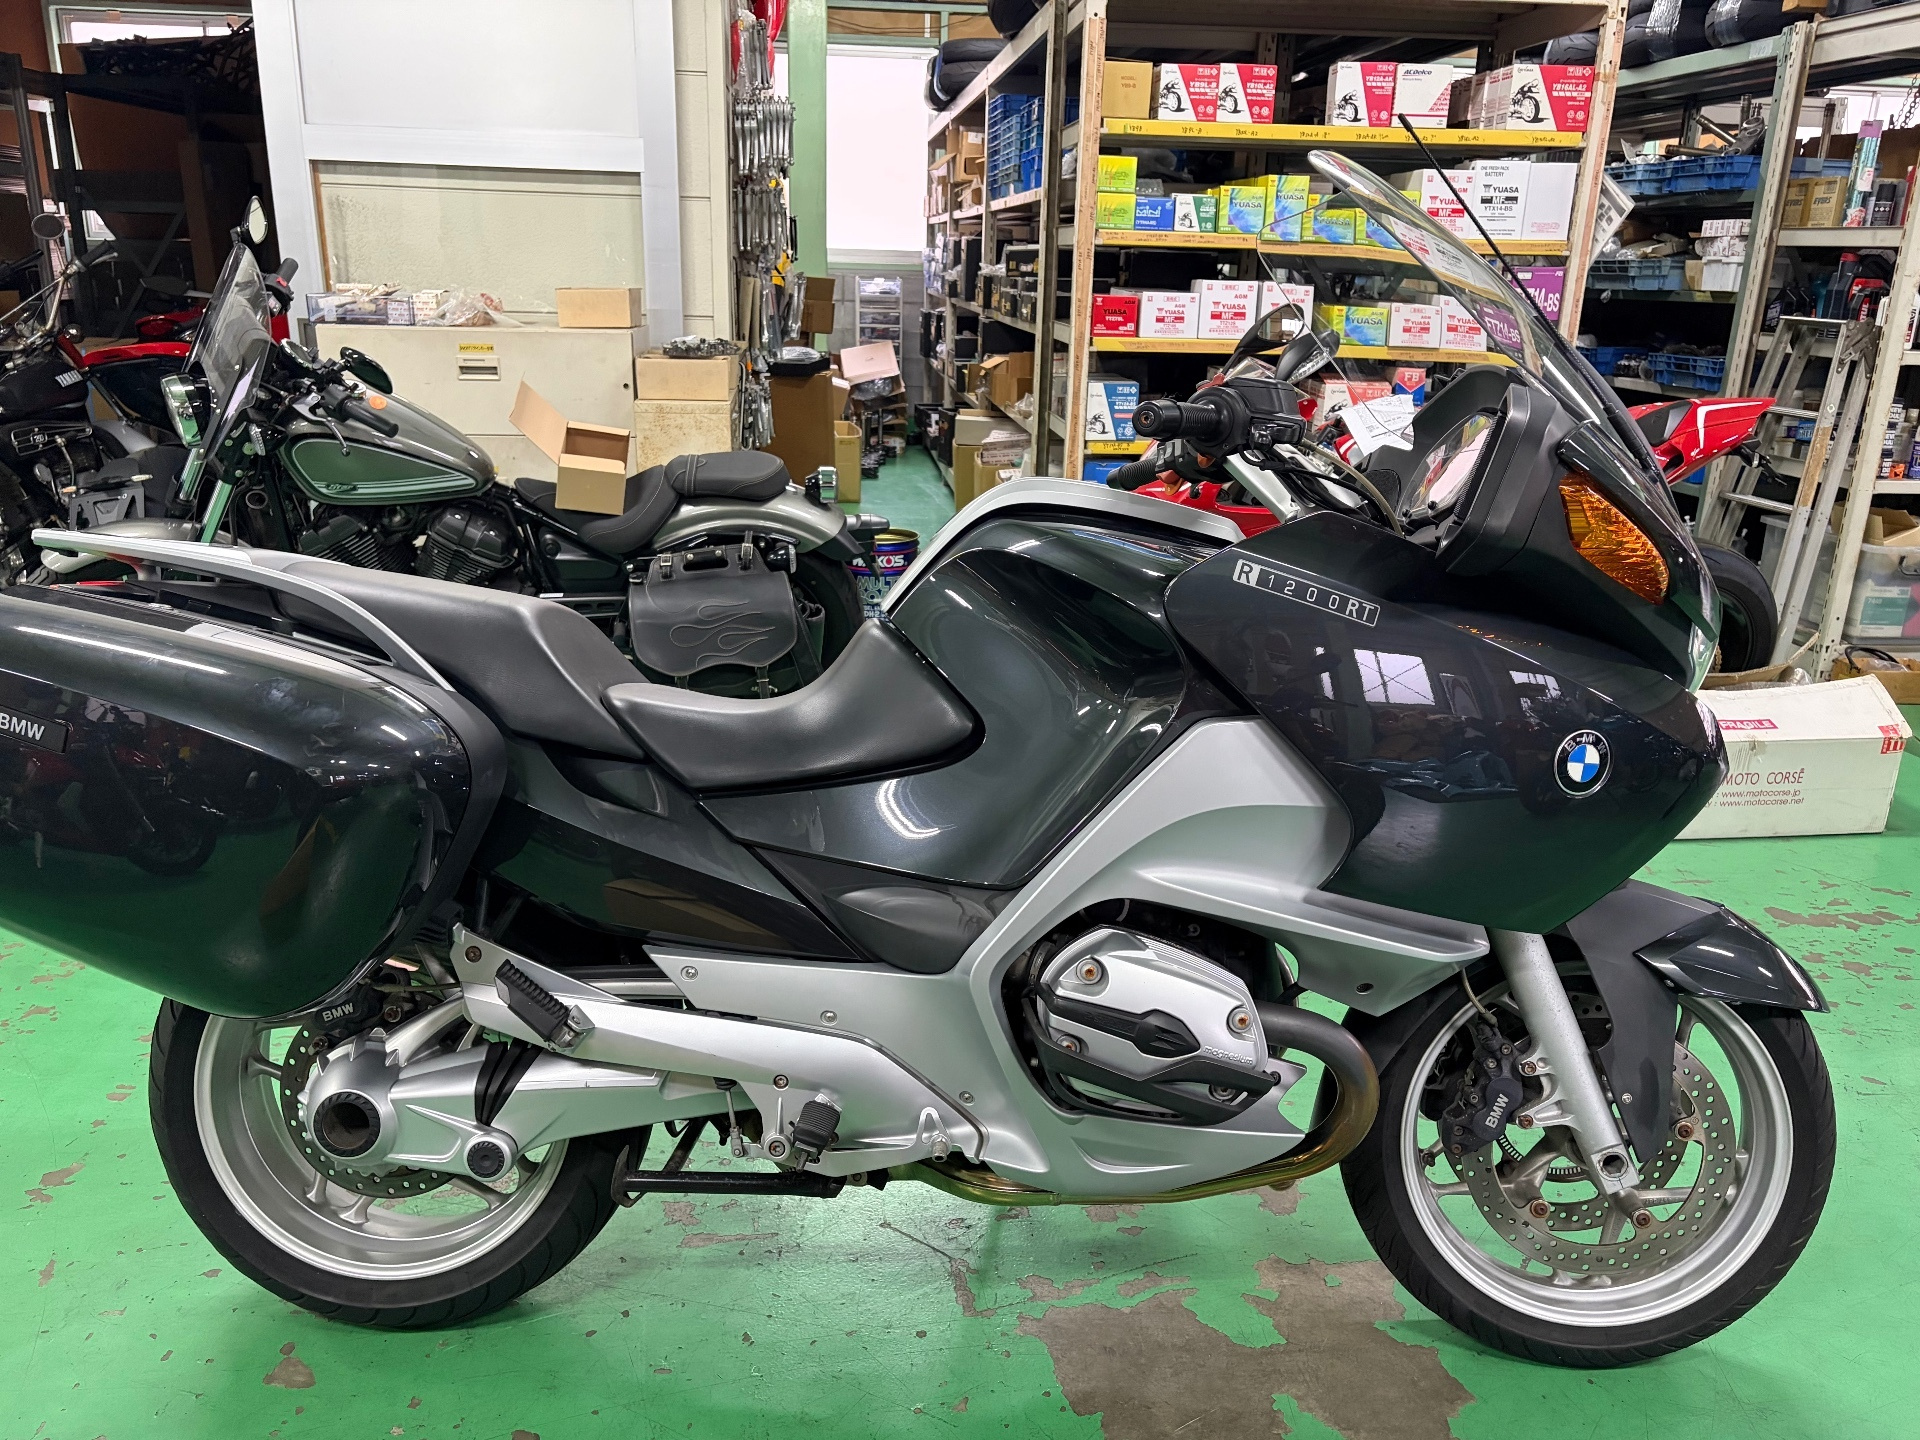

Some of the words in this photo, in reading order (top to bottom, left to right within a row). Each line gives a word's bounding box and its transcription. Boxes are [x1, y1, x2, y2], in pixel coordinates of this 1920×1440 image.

[1552, 83, 1588, 92] YB16AL-A2
[1493, 186, 1520, 194] YUASA
[1277, 193, 1305, 201] YUASA
[1438, 197, 1464, 206] YUAS
[1233, 201, 1262, 209] YUASA
[1438, 208, 1452, 217] MF
[1317, 217, 1351, 226] YUASA
[1221, 303, 1247, 311] YUASA
[1103, 308, 1128, 316] YUASA
[1221, 312, 1235, 320] MF
[1350, 317, 1384, 326] YUASA
[1456, 317, 1479, 325] YUAS
[1457, 325, 1469, 334] MF
[1404, 372, 1420, 382] FB
[857, 575, 900, 591] MULT
[0, 712, 45, 741] BMW
[1720, 720, 1775, 729] FRAGILE
[1564, 733, 1607, 755] BMW
[1723, 772, 1760, 786] MOTO
[1721, 788, 1801, 798] www.motocorse.jp
[1719, 797, 1805, 807] www.motocorse.net
[322, 1002, 354, 1022] BMW
[1204, 1045, 1254, 1065] magnesium
[1485, 1093, 1509, 1129] BMW
